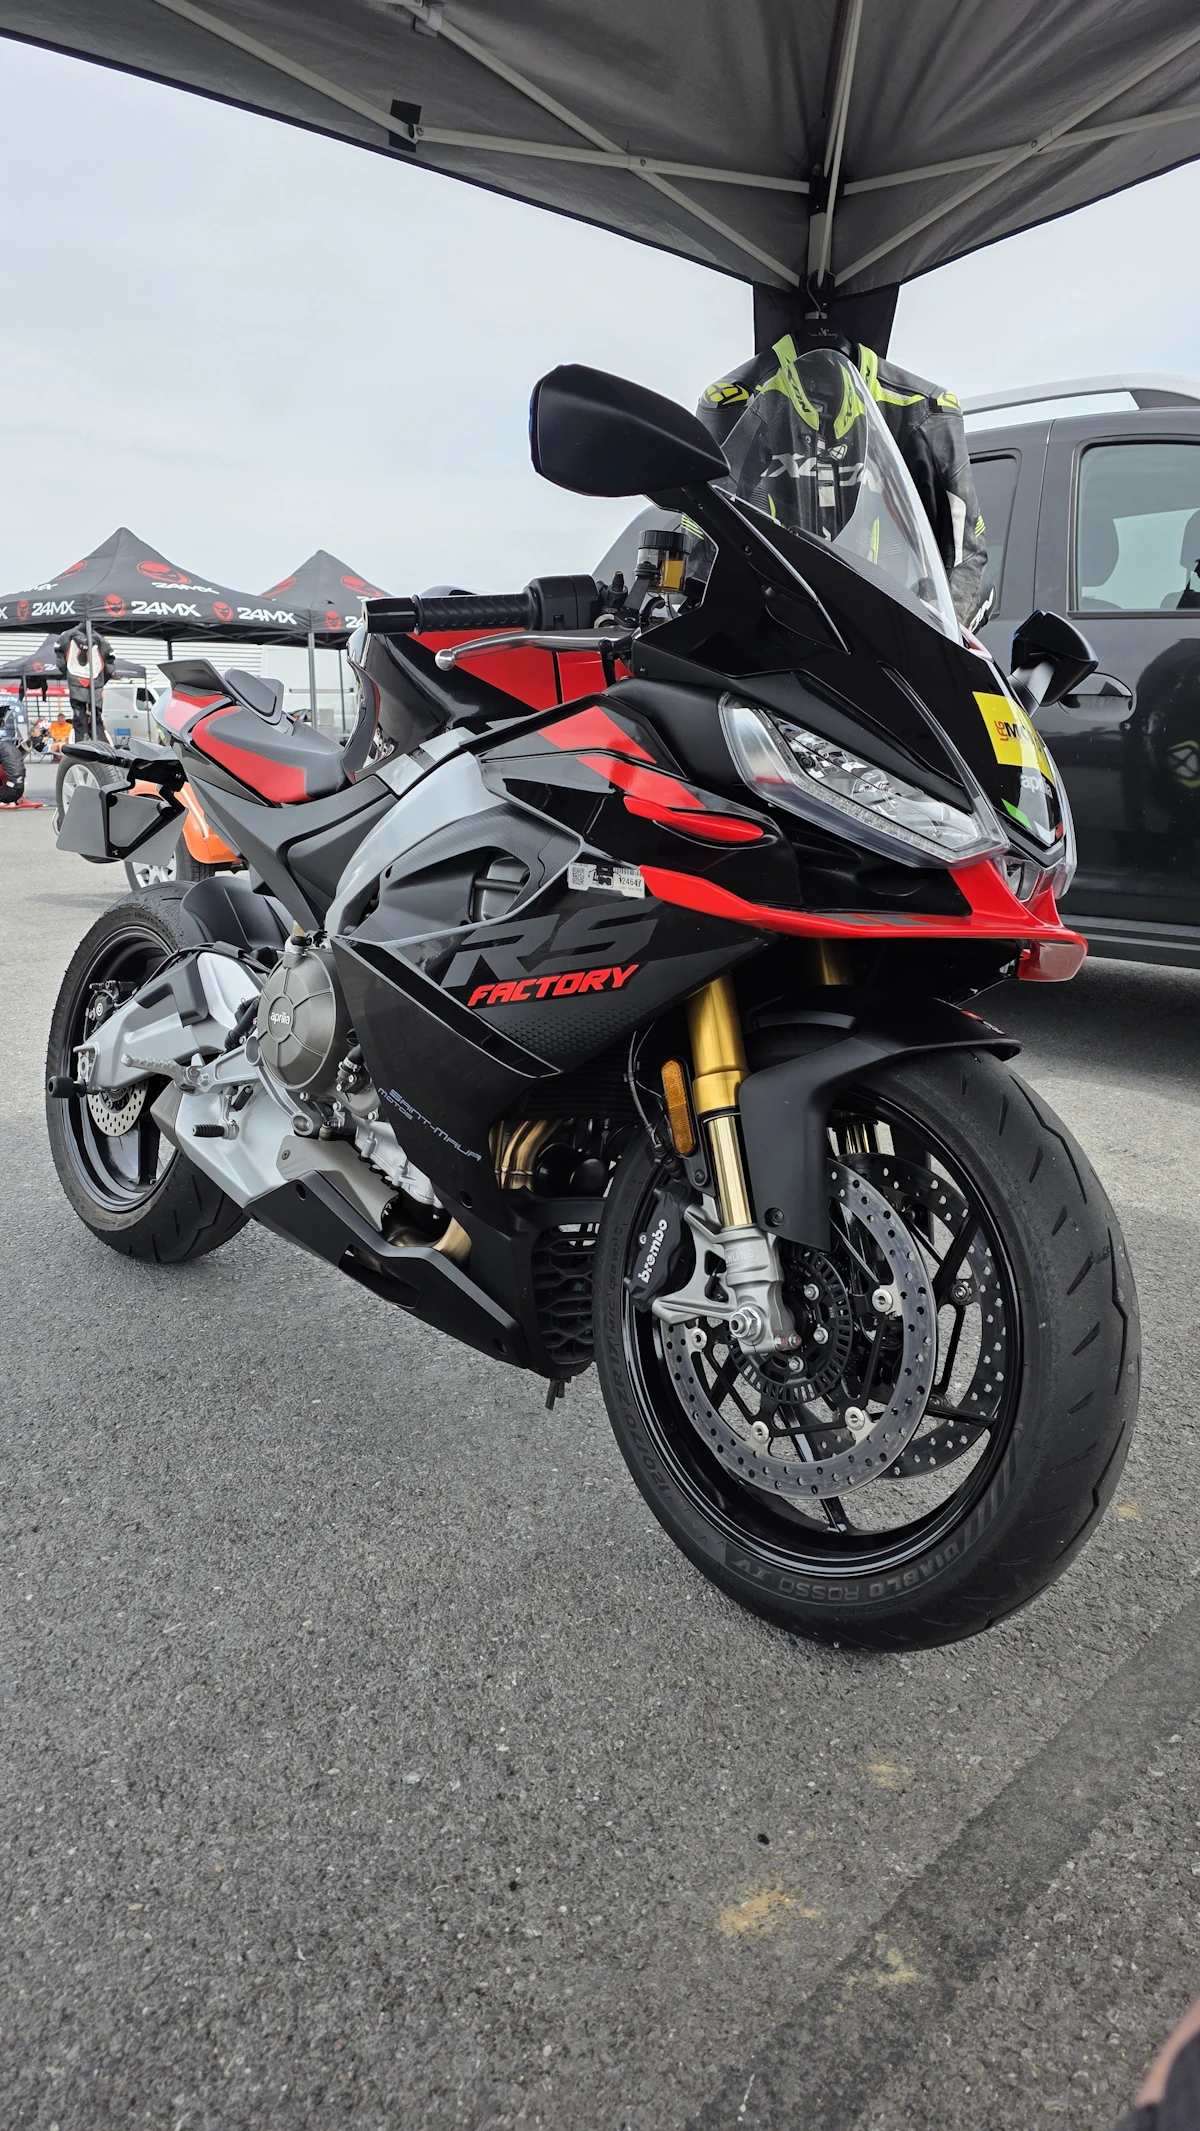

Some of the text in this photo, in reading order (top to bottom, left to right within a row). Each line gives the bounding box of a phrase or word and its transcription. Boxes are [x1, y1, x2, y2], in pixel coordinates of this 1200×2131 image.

[31, 600, 76, 617] 24MX
[130, 600, 202, 618] 24MX
[236, 607, 298, 625] 24MX
[344, 615, 364, 629] 24
[440, 897, 664, 989] RS
[467, 963, 640, 1007] FACTORY
[270, 1011, 291, 1025] aprilia
[389, 1088, 483, 1162] SAINT-MAUR
[637, 1218, 668, 1284] brembo
[624, 1413, 672, 1493] 120/70
[728, 1540, 961, 1602] DIABLO ROSSO IV
